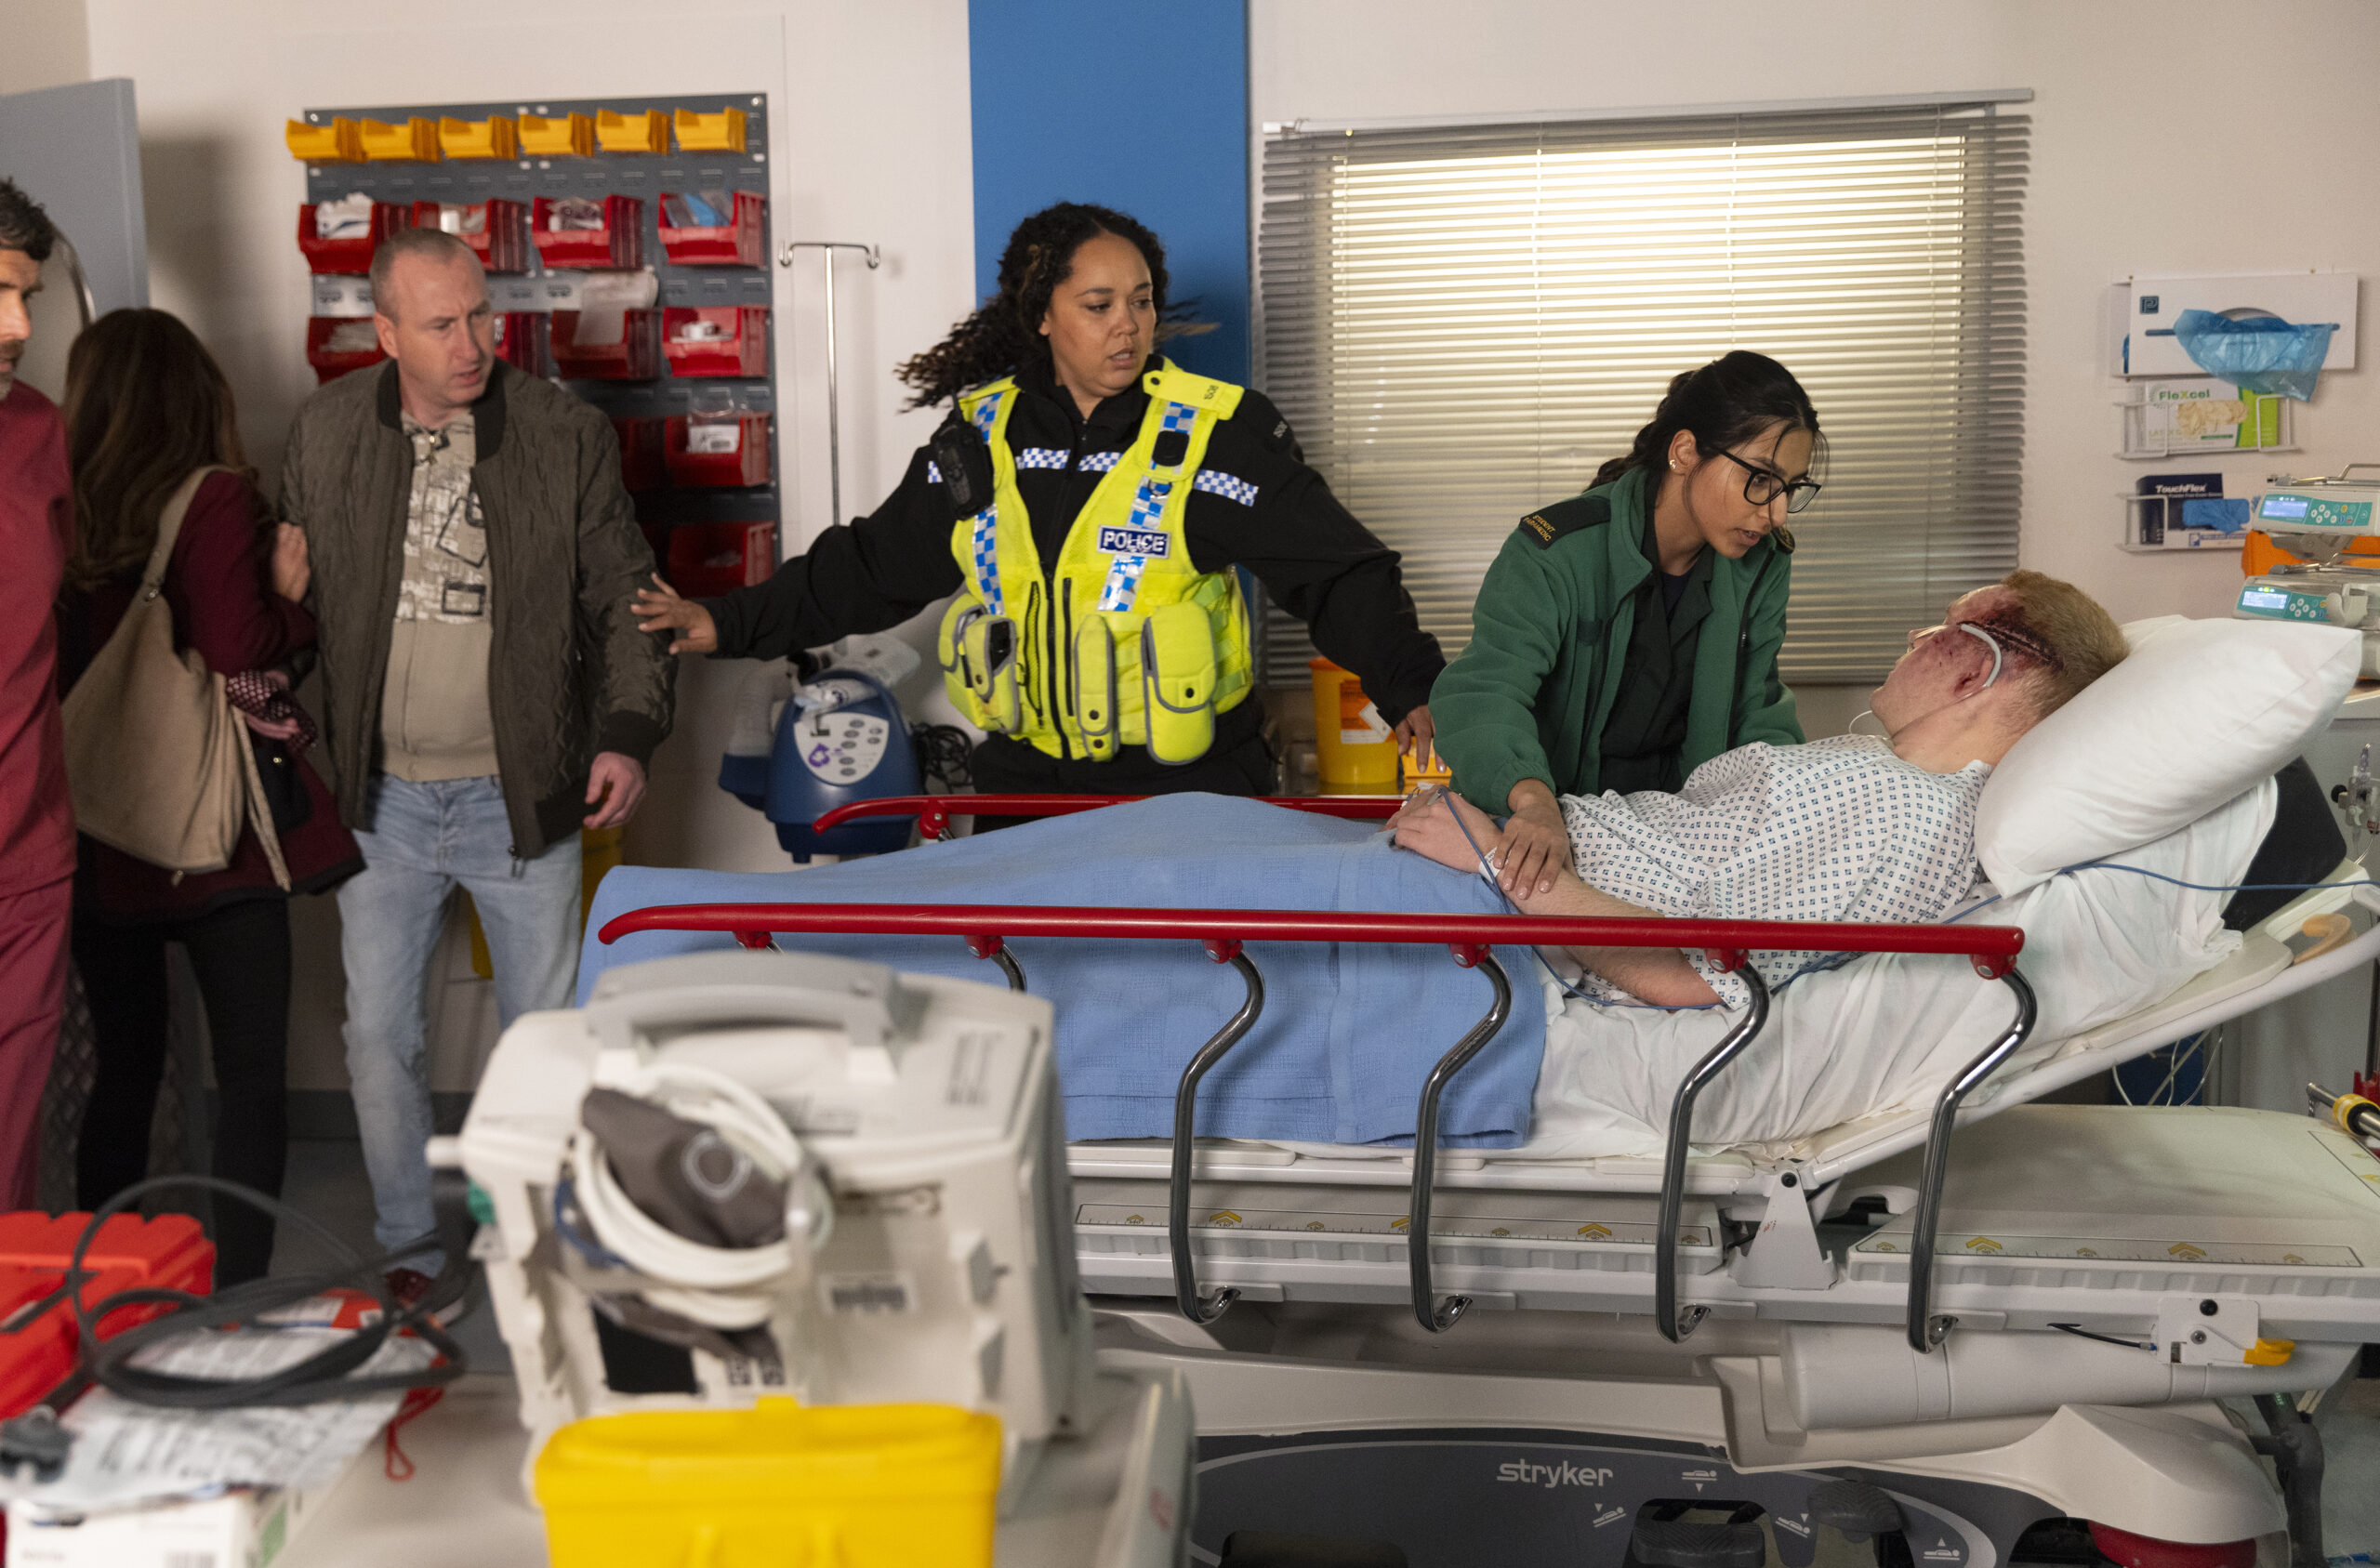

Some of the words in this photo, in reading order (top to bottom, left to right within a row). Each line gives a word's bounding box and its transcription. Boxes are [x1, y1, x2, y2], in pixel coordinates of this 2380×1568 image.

[1523, 517, 1552, 542] PARAMEDIC
[1533, 514, 1555, 533] STUDENT
[1103, 531, 1165, 552] POLICE
[1497, 1458, 1613, 1488] stryker
